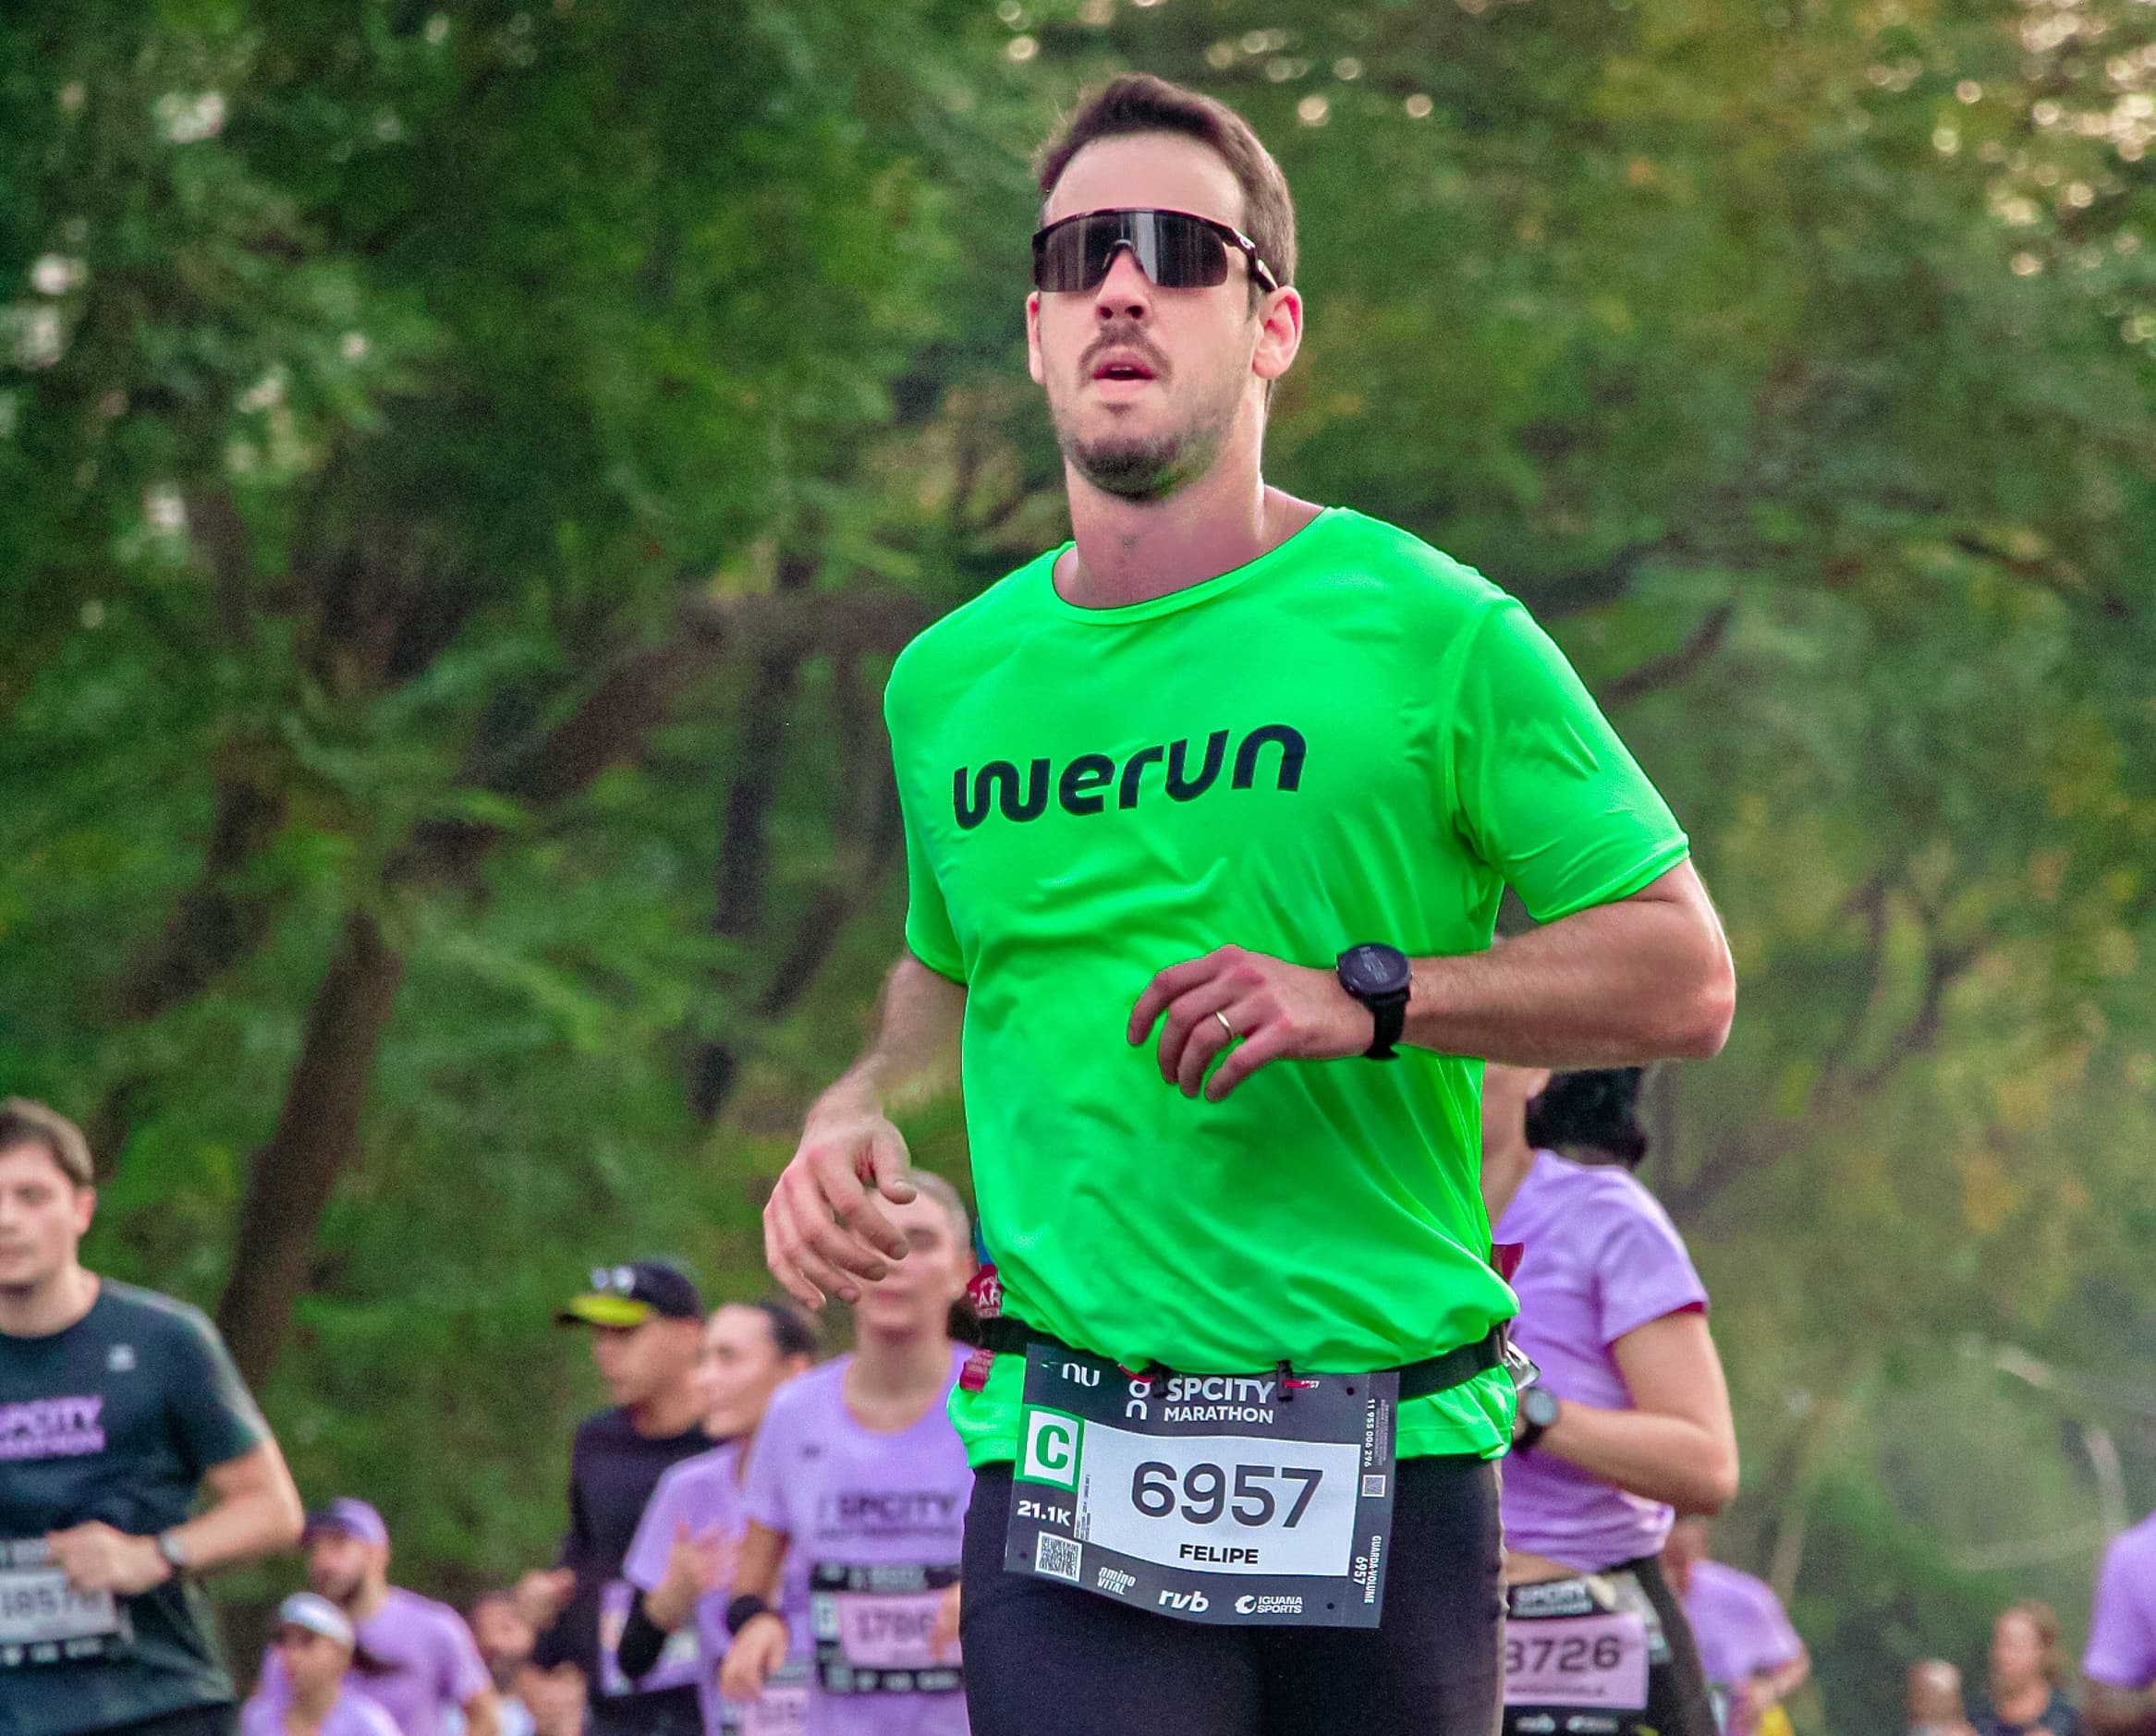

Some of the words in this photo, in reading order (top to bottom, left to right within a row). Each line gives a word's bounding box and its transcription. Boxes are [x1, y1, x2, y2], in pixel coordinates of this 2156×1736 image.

[953, 724, 1307, 831] werun
[1061, 1362, 1101, 1388] nu
[1165, 1378, 1276, 1404] SPCITY
[1366, 1398, 1376, 1409] 11
[1163, 1405, 1274, 1425] MARATHON
[1365, 1411, 1375, 1429] 955
[1034, 1424, 1069, 1471] C
[1364, 1430, 1374, 1449] 006
[1363, 1450, 1373, 1468] 296
[1130, 1460, 1324, 1530] 6957
[1016, 1499, 1072, 1527] 21.1K
[1178, 1543, 1260, 1565] FELIPE
[1098, 1566, 1137, 1587] amino
[1352, 1556, 1368, 1585] 6957
[1096, 1579, 1126, 1596] VITAL
[1158, 1589, 1211, 1614] rvb
[1257, 1604, 1303, 1615] SPORTS
[1258, 1596, 1303, 1607] IGUANA
